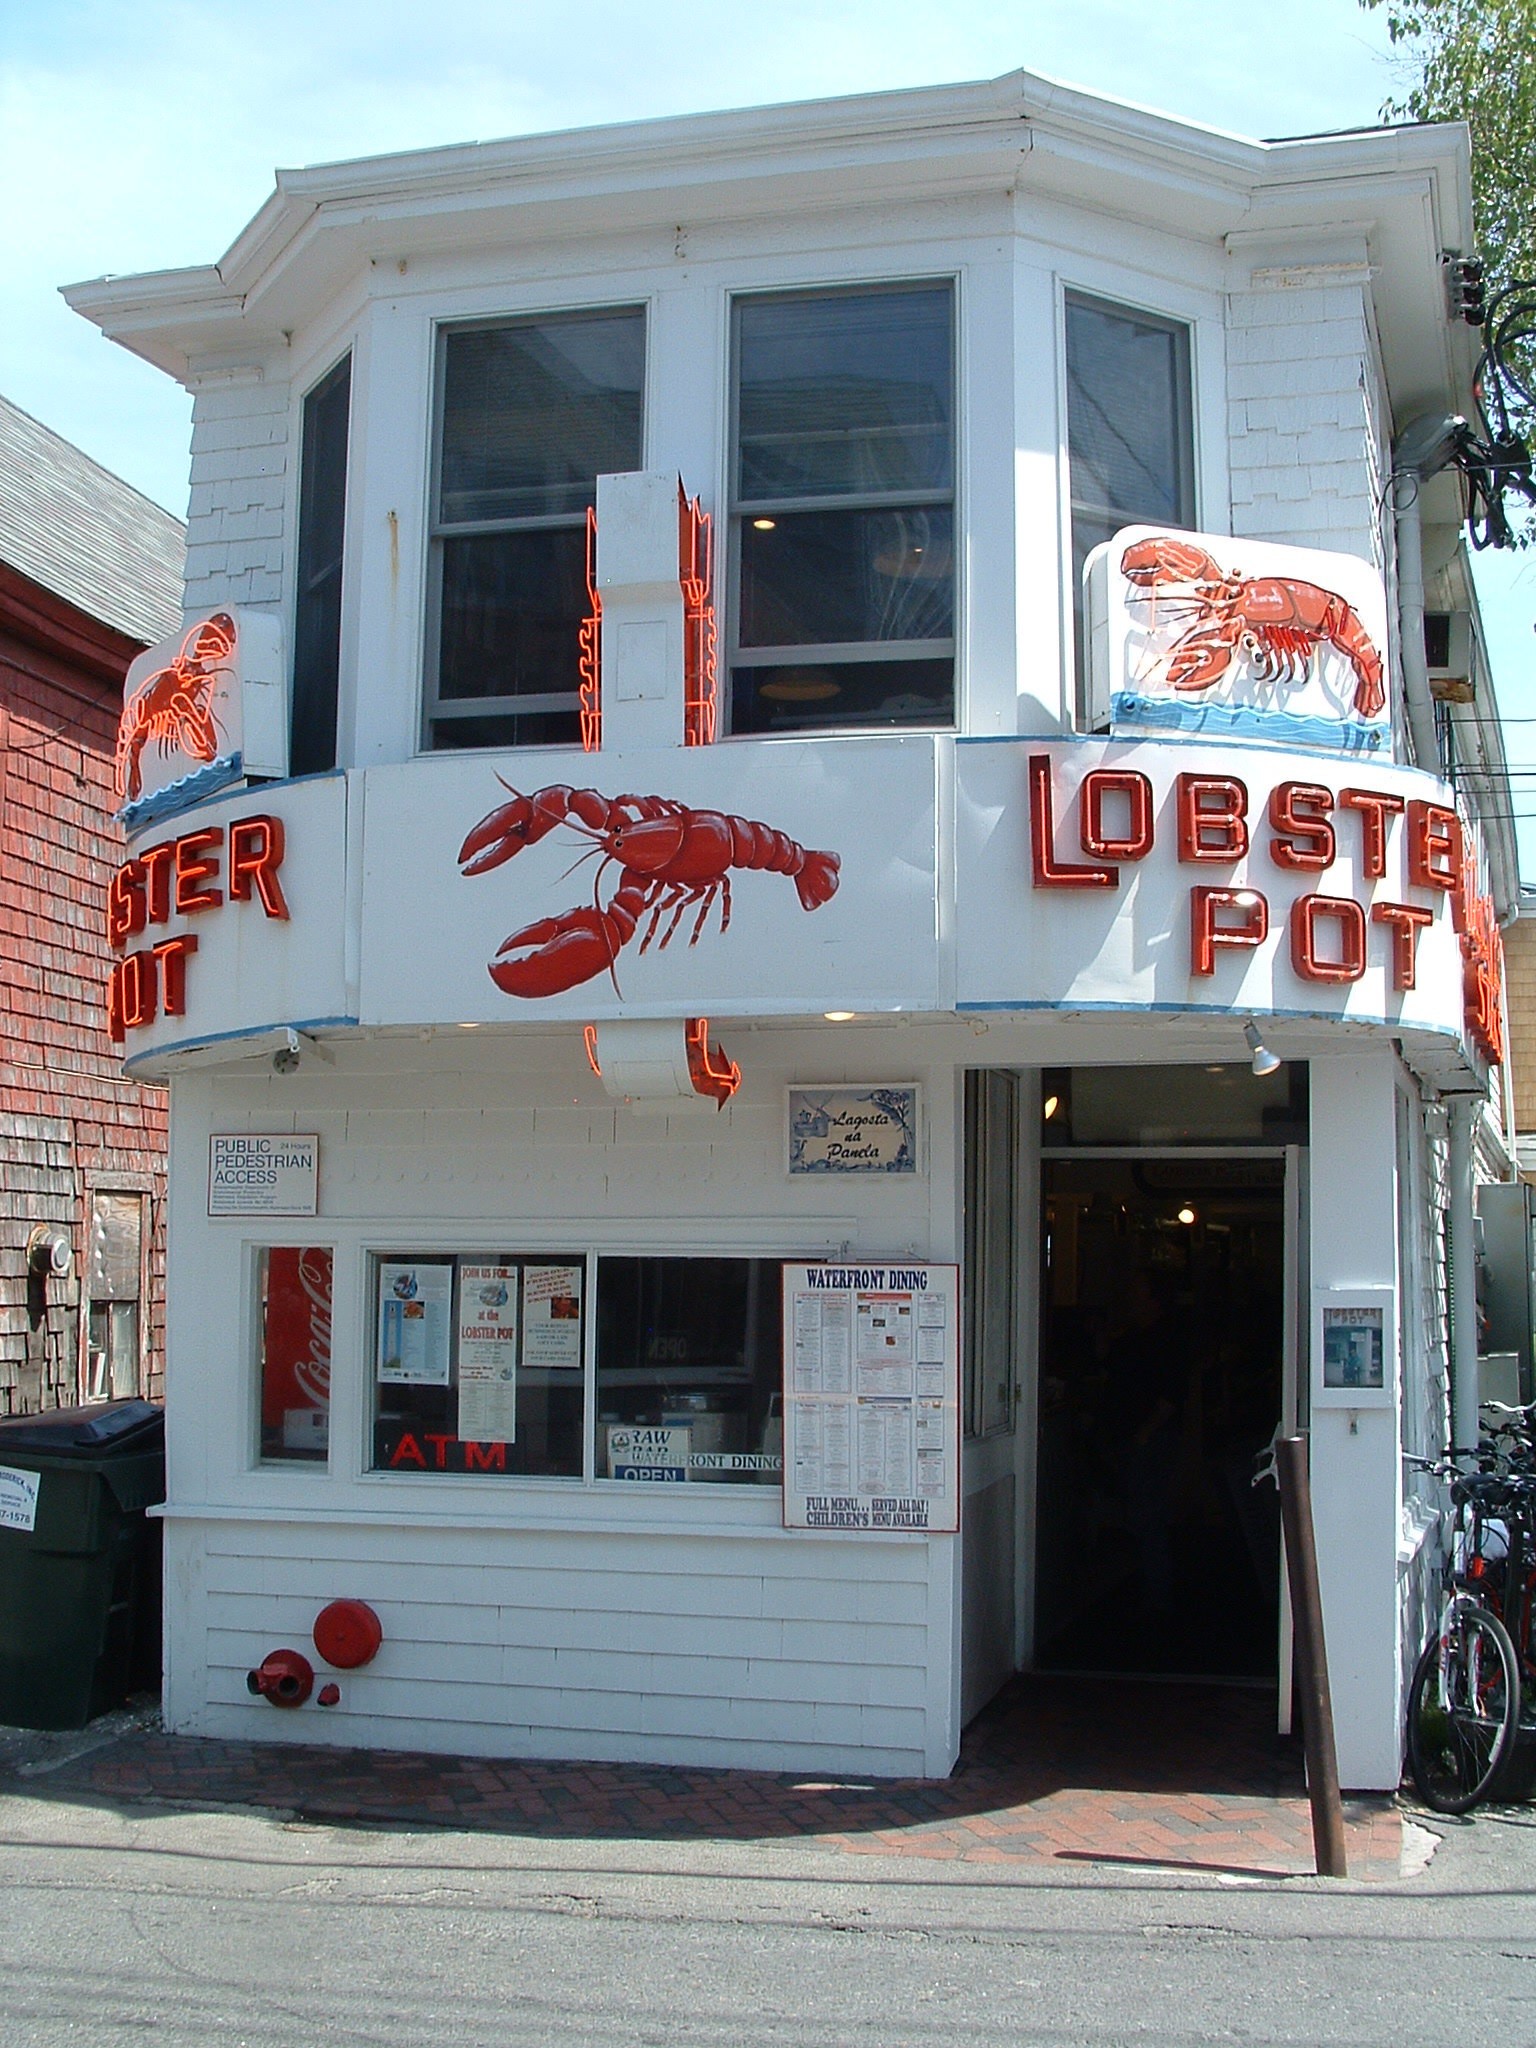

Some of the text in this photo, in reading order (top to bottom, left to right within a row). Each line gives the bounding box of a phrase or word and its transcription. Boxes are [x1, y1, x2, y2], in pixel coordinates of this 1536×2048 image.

[1029, 755, 1462, 892] LOBSTE
[107, 814, 290, 948] STER
[1191, 885, 1432, 990] POT
[107, 934, 198, 1043] OT
[833, 1111, 889, 1130] Lagosta
[844, 1132, 862, 1142] na
[215, 1139, 271, 1153] PUBLIC
[216, 1154, 312, 1168] PEDESTRIAN
[215, 1170, 277, 1184] ACCESS
[462, 1267, 480, 1280] JOIN
[481, 1268, 491, 1278] US
[806, 1268, 928, 1291] WATERFRONT DINING
[462, 1326, 513, 1340] LOBSTER POT
[632, 1429, 671, 1444] RAW
[390, 1432, 506, 1471] ATM
[731, 1454, 783, 1469] DINING
[624, 1468, 676, 1481] OPEN
[806, 1496, 829, 1511] FULL
[872, 1498, 898, 1512] SERVED
[899, 1499, 911, 1513] ALL
[0, 1510, 31, 1524] 7-1578
[806, 1511, 929, 1528] CHILDREN'S MENU AVAILABLE
